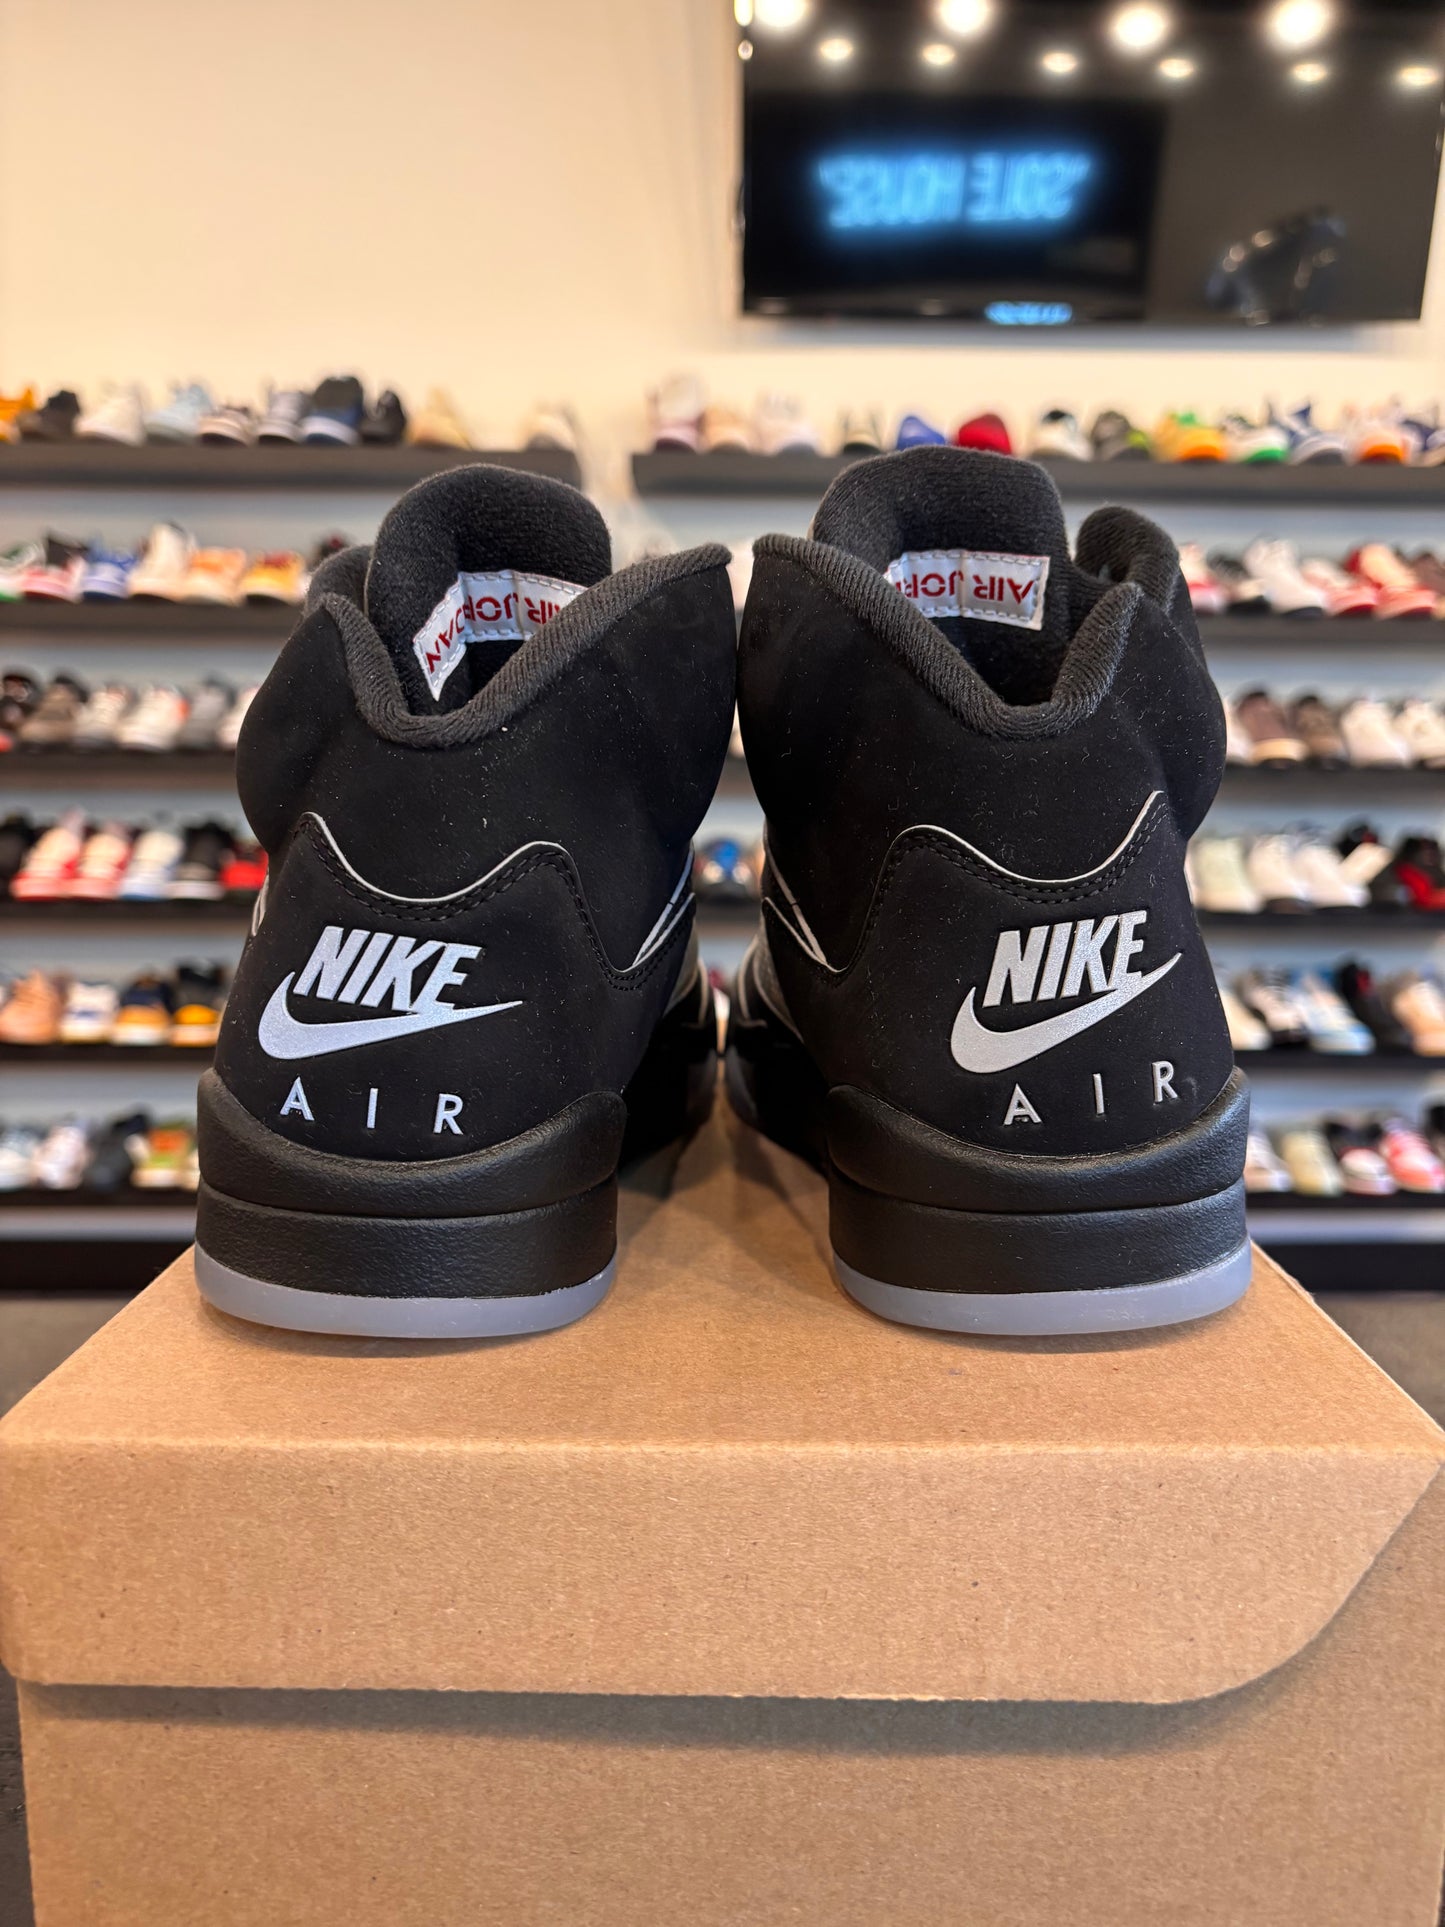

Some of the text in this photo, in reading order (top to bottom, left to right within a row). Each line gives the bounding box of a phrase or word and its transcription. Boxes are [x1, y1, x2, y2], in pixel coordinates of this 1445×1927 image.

[524, 597, 560, 625] IR
[972, 574, 1035, 604] AIR
[293, 926, 483, 1014] NIKE
[982, 910, 1147, 1008] NIKE
[280, 1077, 463, 1135] AIR
[1003, 1061, 1178, 1125] AIR
